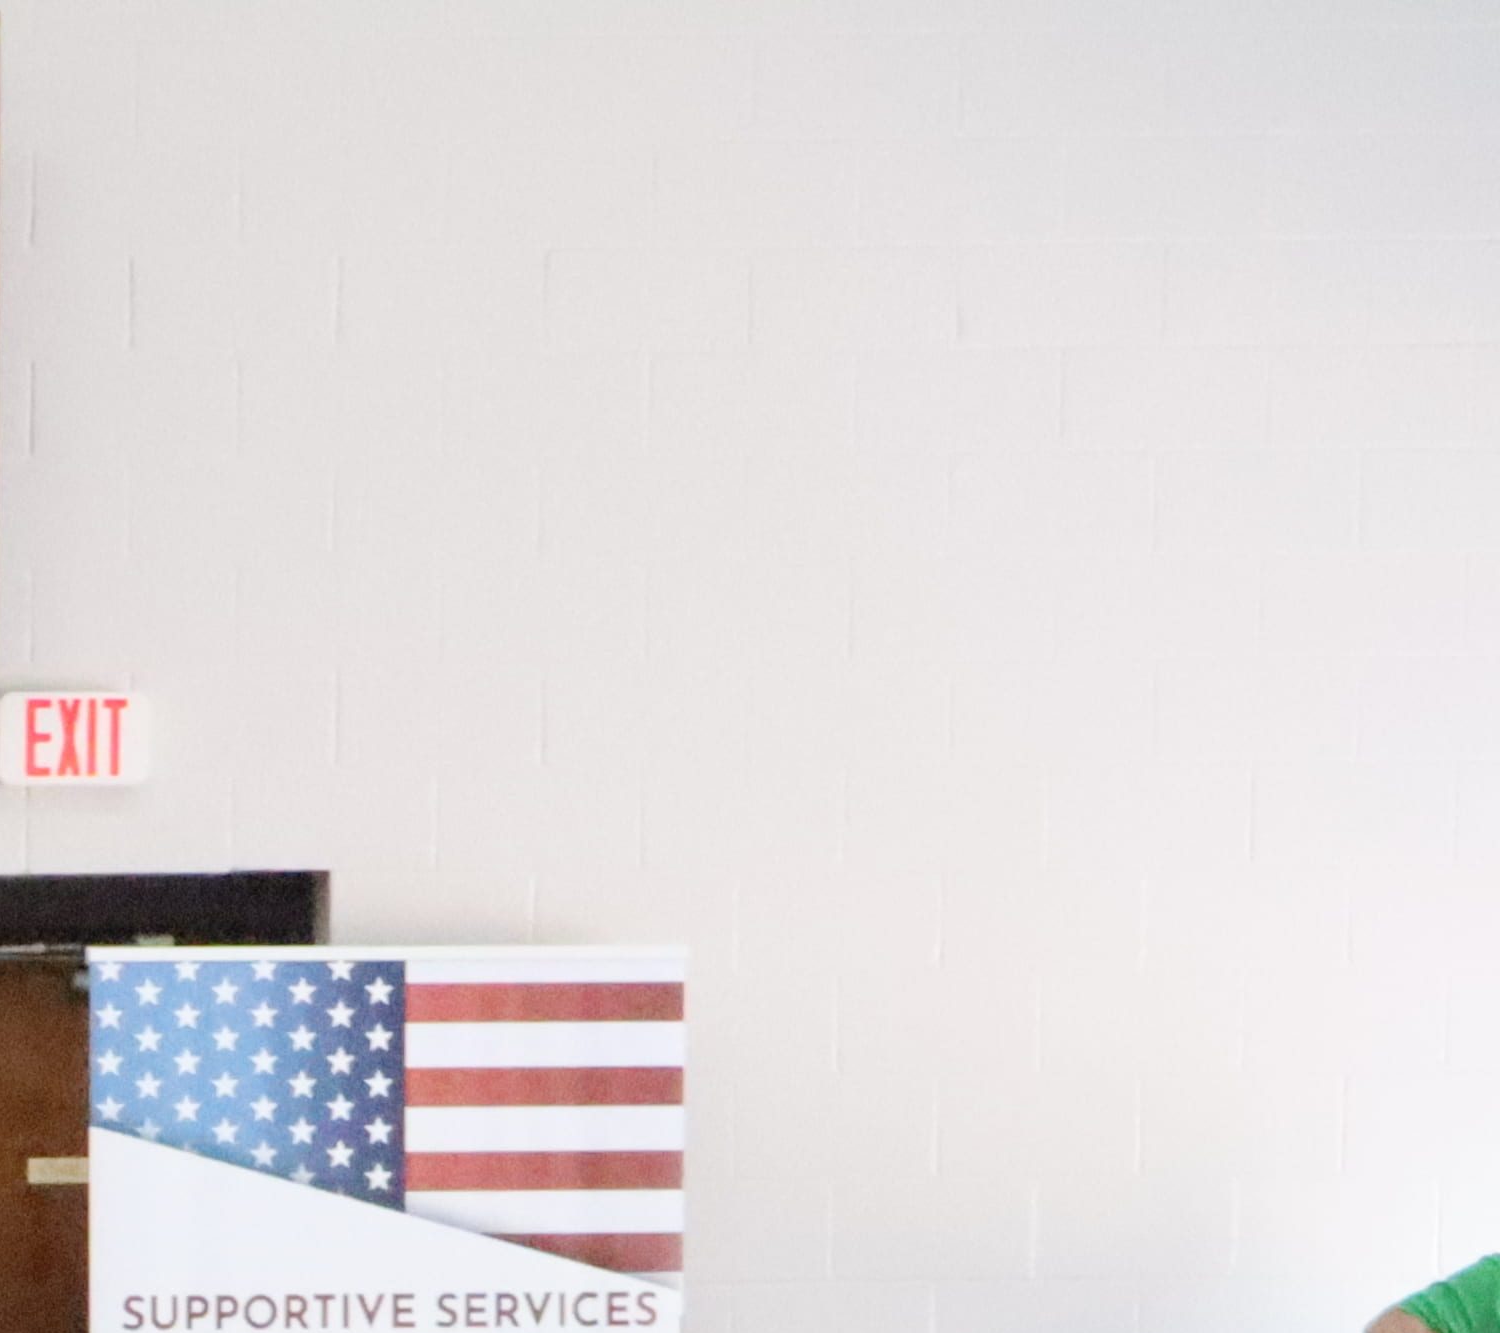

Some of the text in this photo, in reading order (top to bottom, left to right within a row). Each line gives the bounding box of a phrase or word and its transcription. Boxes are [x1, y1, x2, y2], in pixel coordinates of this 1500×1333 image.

[25, 698, 129, 777] EXIT
[122, 1291, 659, 1331] SUPPORTIVE SERVICES
